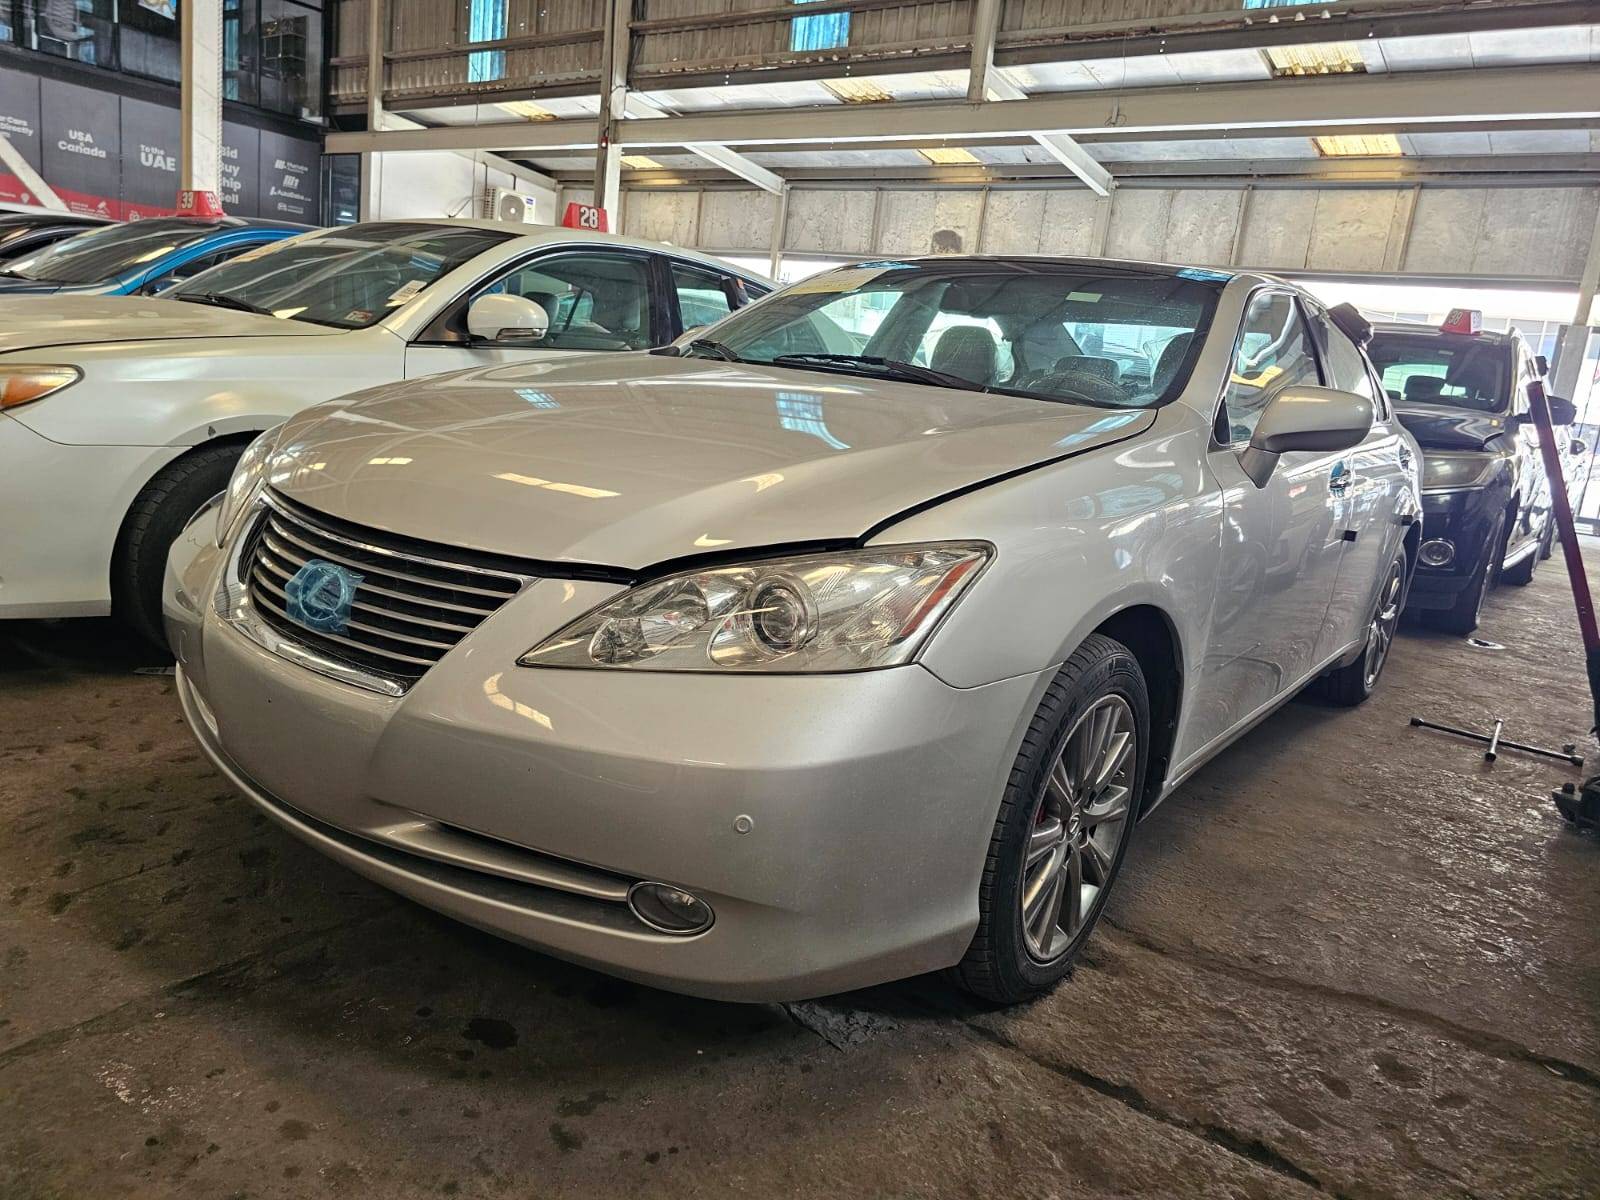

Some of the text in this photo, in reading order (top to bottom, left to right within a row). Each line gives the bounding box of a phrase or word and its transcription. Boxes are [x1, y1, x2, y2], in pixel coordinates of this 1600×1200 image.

[68, 129, 93, 143] USA
[58, 140, 106, 158] Canada
[140, 152, 176, 171] UAE
[221, 176, 242, 192] hip
[181, 191, 194, 209] 33
[580, 206, 598, 229] 28
